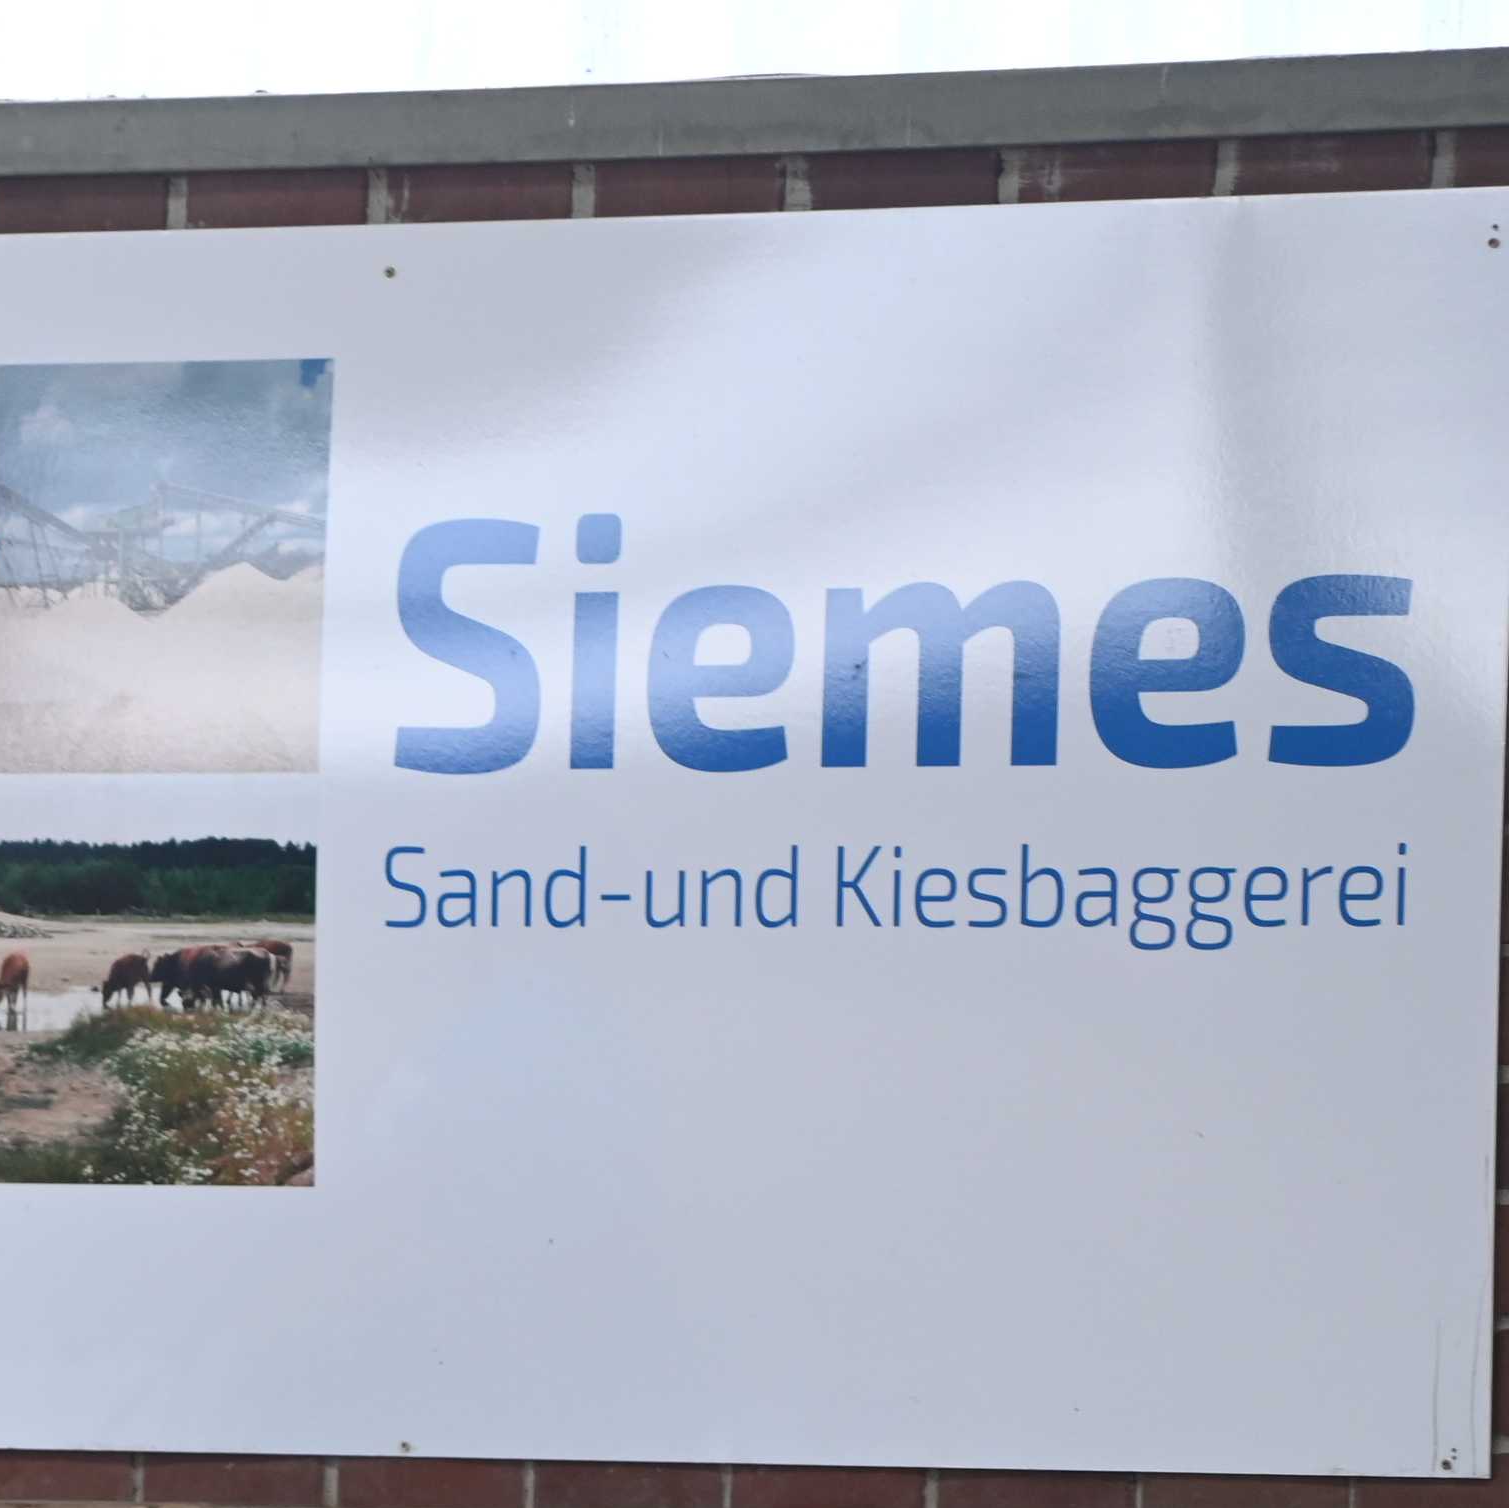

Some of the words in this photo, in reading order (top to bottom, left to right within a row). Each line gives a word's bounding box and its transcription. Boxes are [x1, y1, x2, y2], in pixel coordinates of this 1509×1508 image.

[392, 511, 1419, 777] Siemes
[383, 842, 801, 930] Sand-und
[836, 842, 1411, 952] Kiesbaggerei
